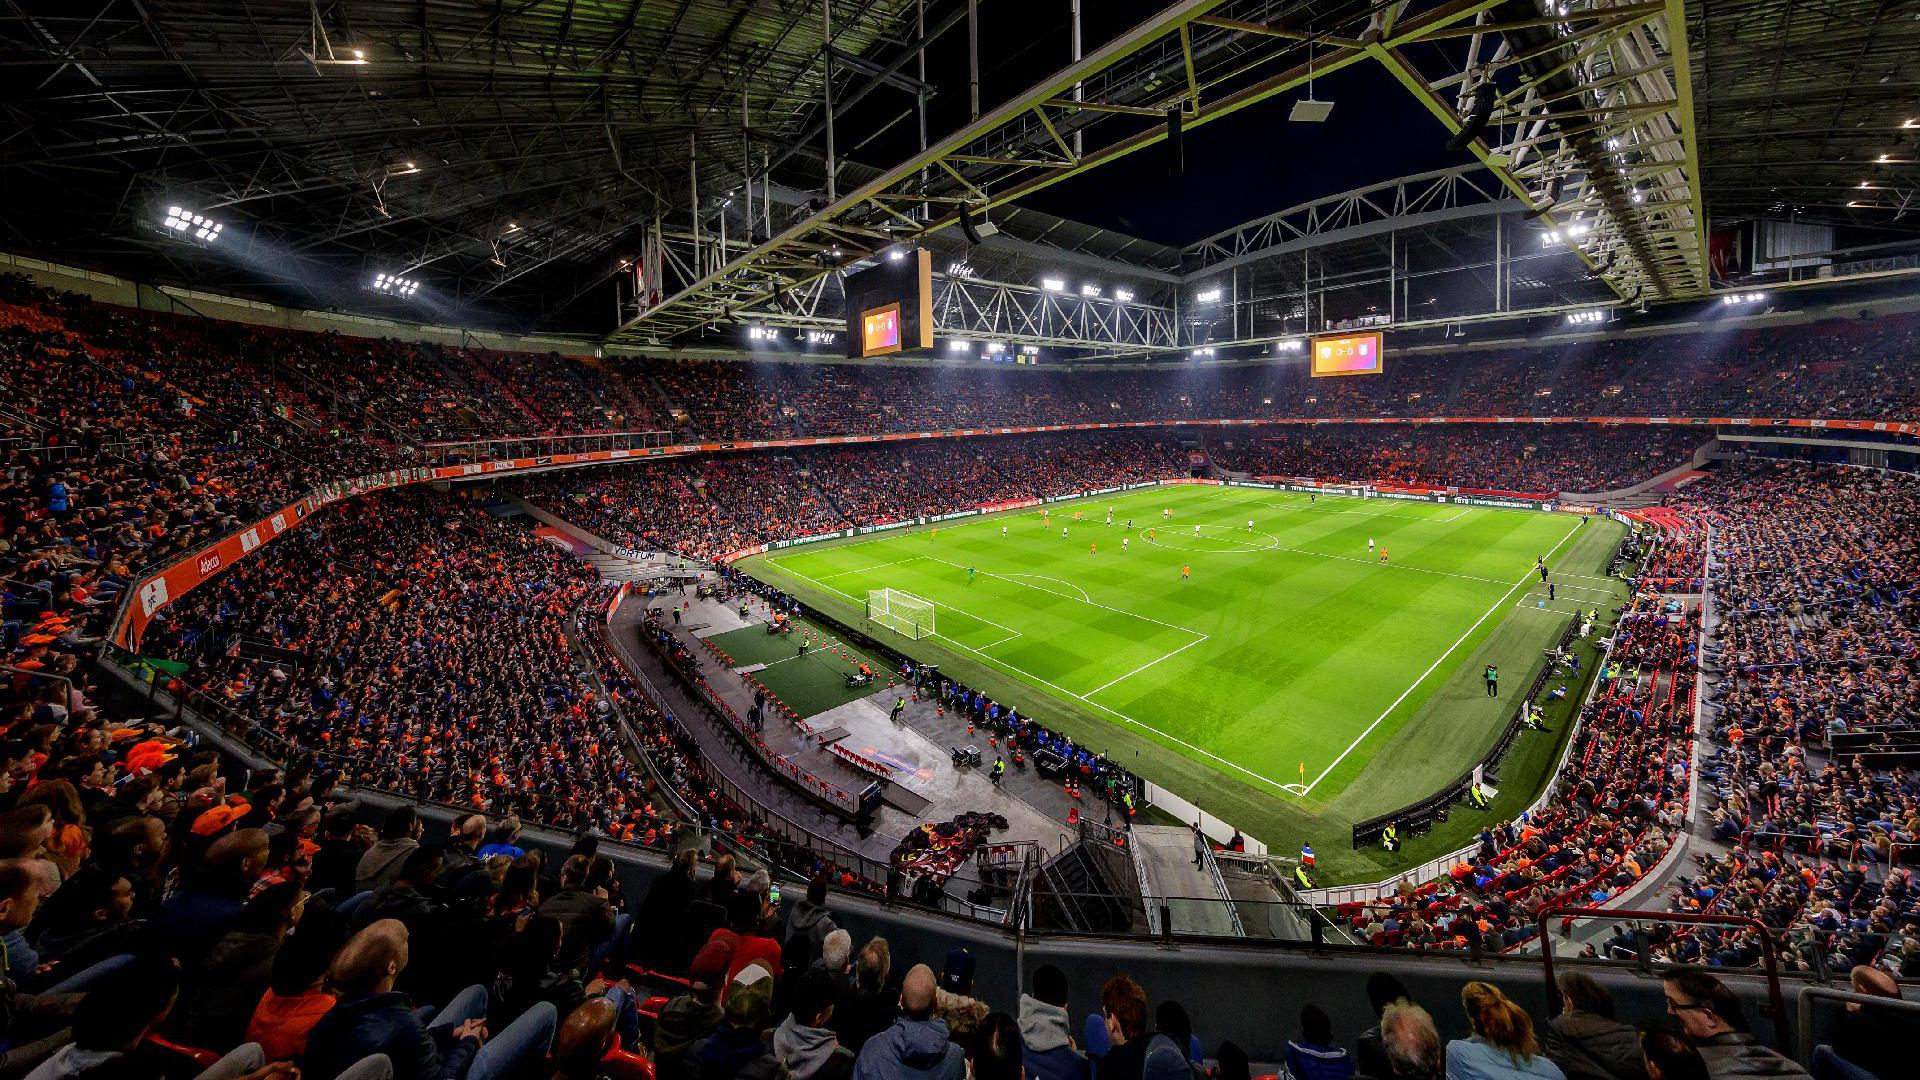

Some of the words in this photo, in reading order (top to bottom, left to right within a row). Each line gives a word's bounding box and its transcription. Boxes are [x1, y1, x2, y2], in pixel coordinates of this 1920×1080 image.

[1336, 347, 1354, 356] 0-0
[615, 547, 656, 561] VORTUM
[200, 555, 220, 575] Adecco
